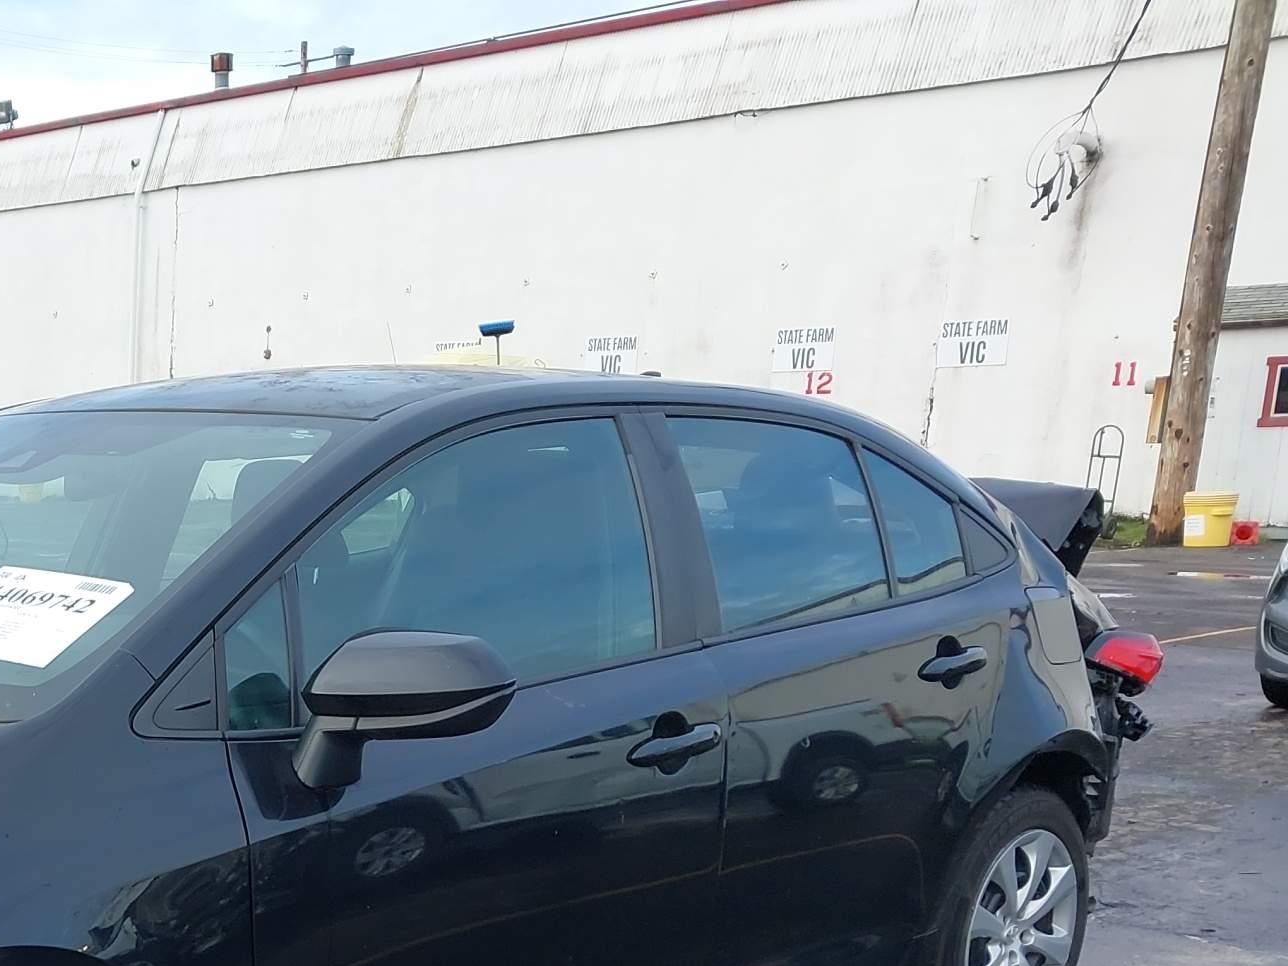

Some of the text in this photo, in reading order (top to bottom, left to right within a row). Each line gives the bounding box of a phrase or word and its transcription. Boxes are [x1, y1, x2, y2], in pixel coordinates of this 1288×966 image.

[777, 327, 834, 344] STATE FARM
[942, 319, 1009, 338] STATE FARM
[588, 336, 637, 352] STATE FARM
[959, 340, 987, 365] VIC
[600, 354, 622, 374] VIC
[791, 347, 816, 370] VIC
[805, 372, 833, 395] 12
[1111, 361, 1137, 386] 11
